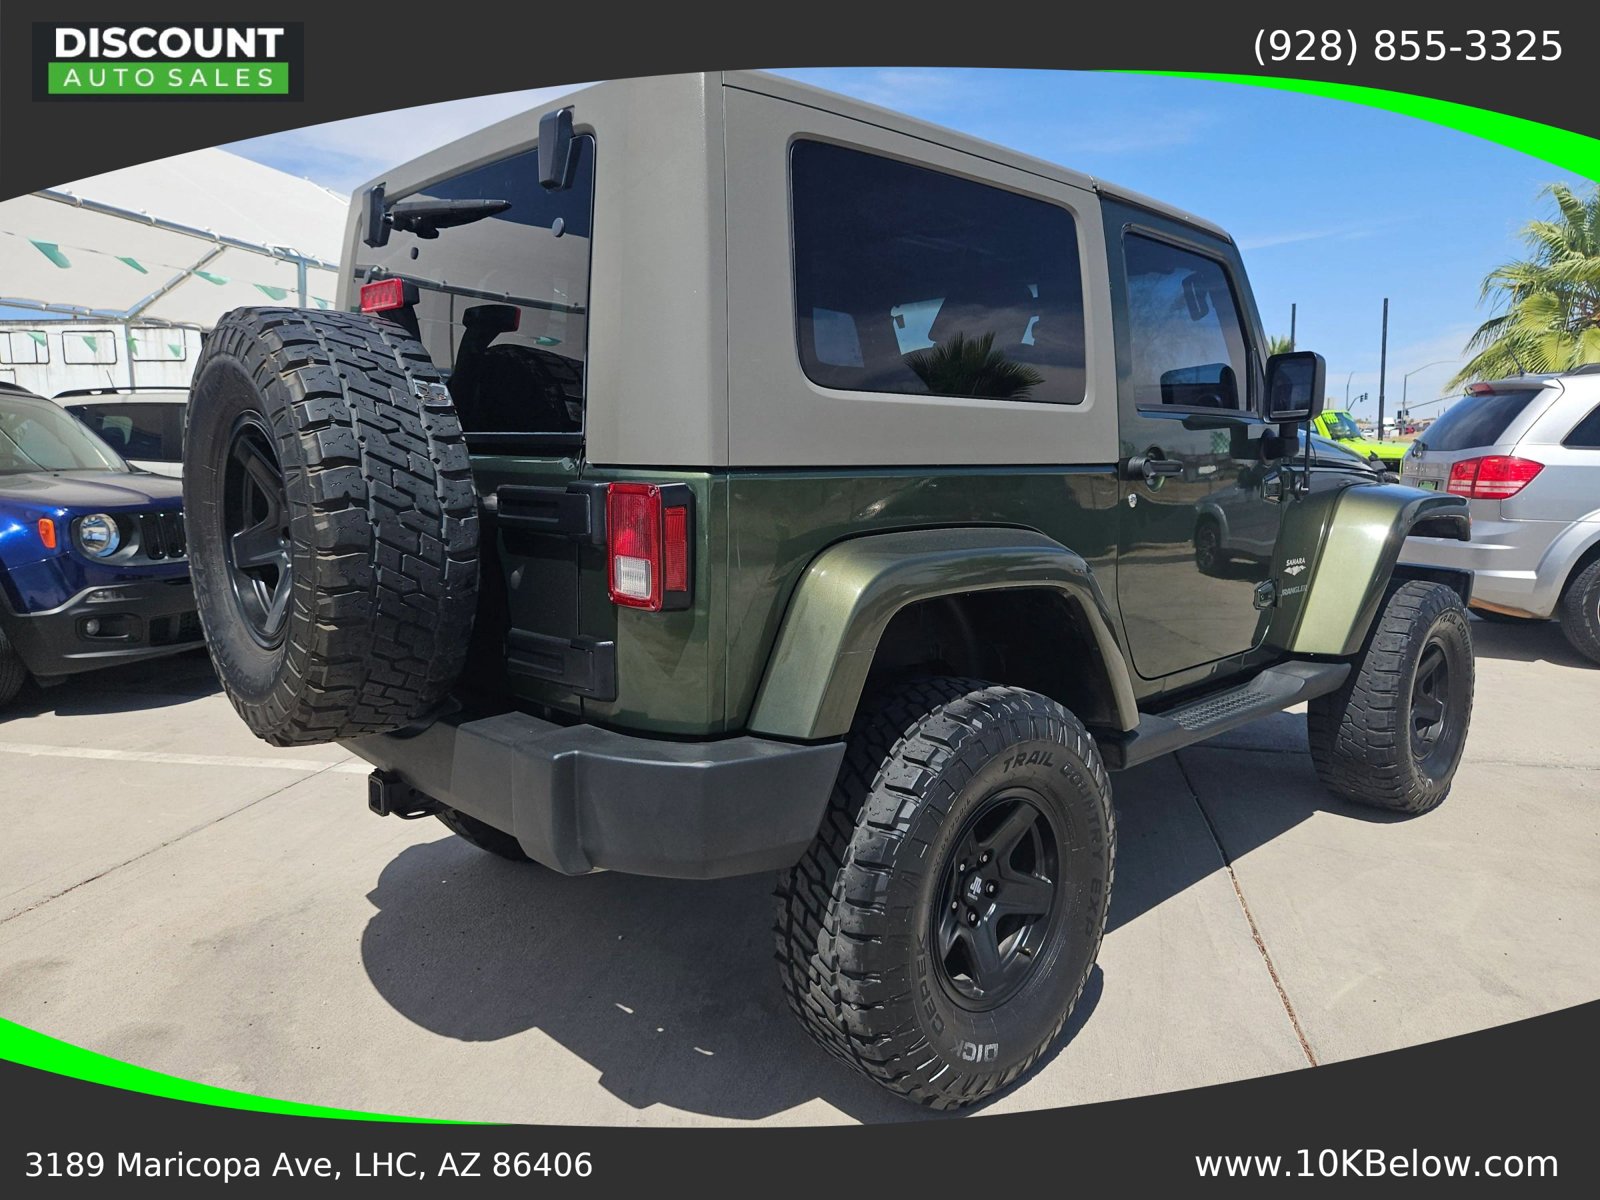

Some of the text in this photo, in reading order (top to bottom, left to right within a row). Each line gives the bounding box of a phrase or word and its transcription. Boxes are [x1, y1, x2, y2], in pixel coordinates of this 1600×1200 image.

[1286, 557, 1306, 567] SAHARA
[1439, 612, 1457, 626] TRAIL
[1003, 750, 1054, 773] TRAIL
[950, 1036, 999, 1063] DICK
